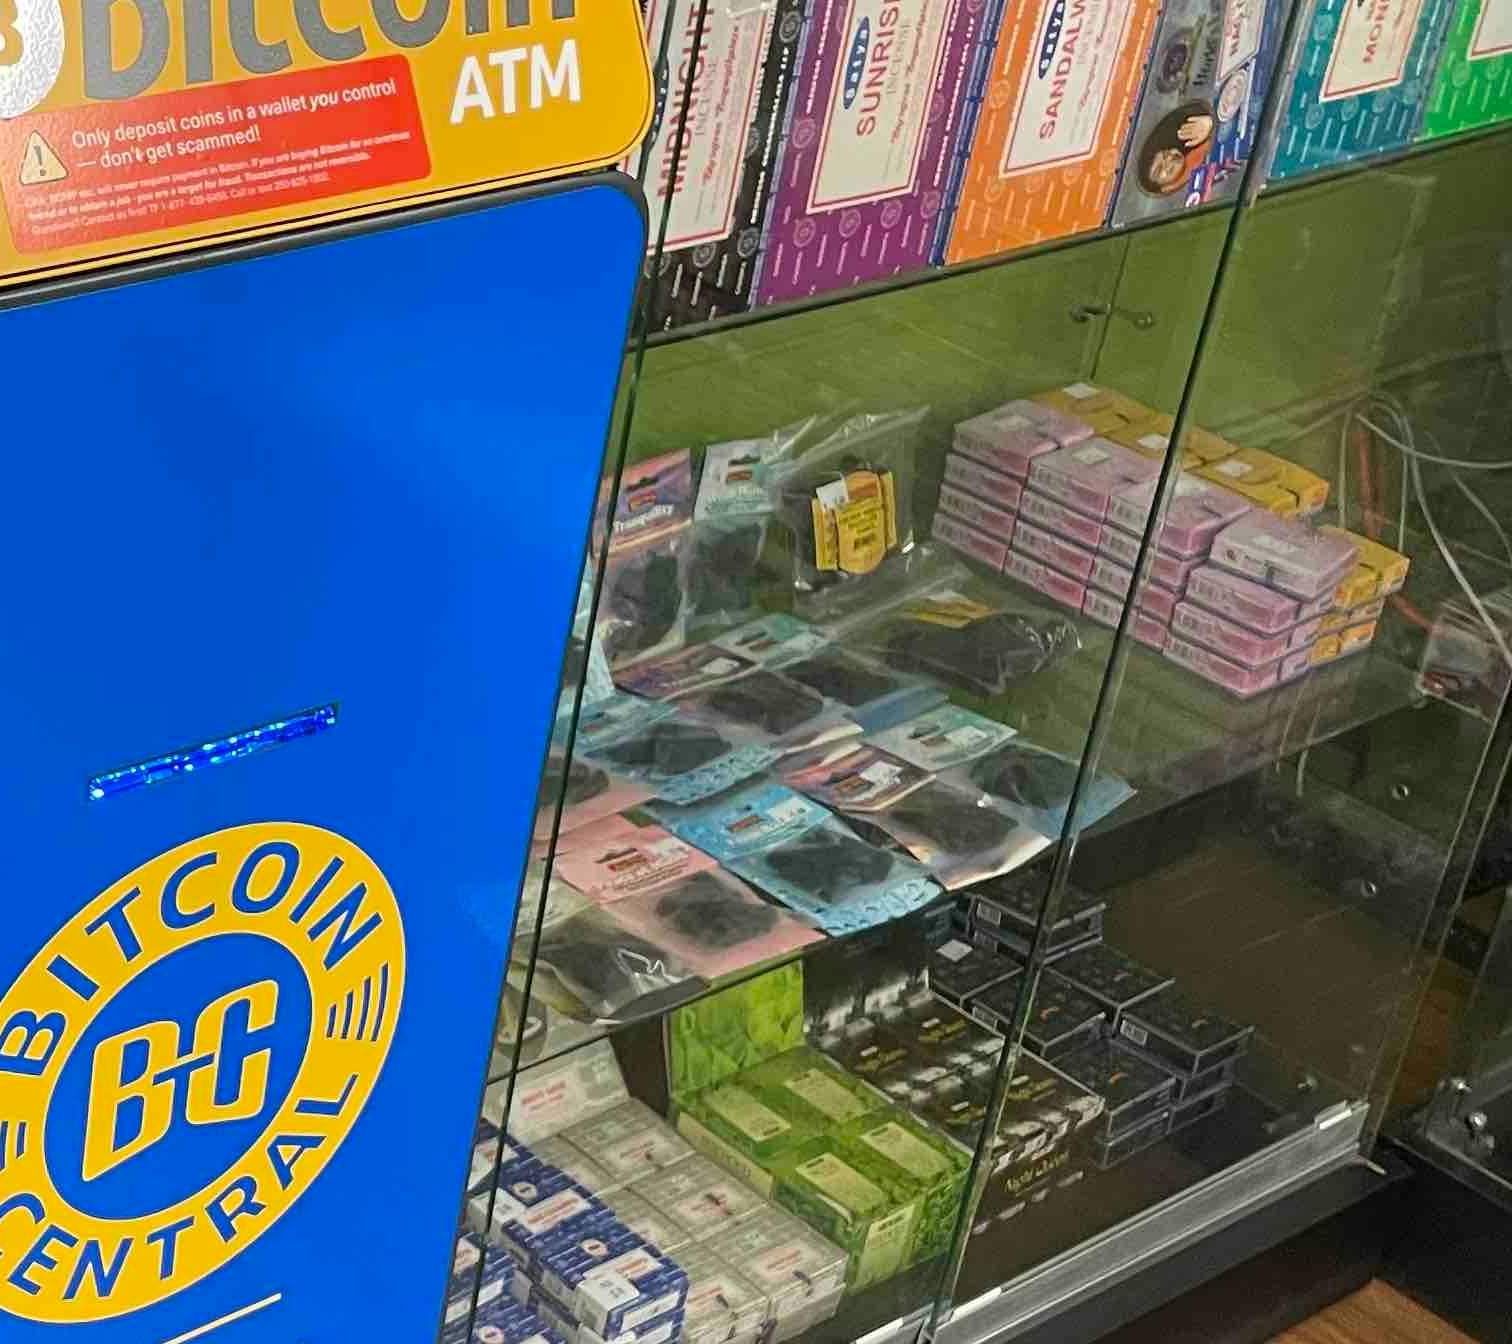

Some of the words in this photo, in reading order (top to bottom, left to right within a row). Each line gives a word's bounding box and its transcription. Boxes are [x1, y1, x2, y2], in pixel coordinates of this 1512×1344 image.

[72, 127, 111, 149] Only
[115, 116, 178, 142] deposit
[180, 110, 225, 131] coins
[227, 105, 245, 123] in
[246, 107, 257, 120] a
[259, 95, 308, 118] wallet
[308, 92, 339, 113] you
[341, 77, 397, 103] control
[449, 38, 583, 126] ATM
[657, 0, 715, 199] MIDNIGHT
[100, 145, 145, 169] don't
[145, 141, 174, 165] get
[176, 123, 261, 155] scammed!
